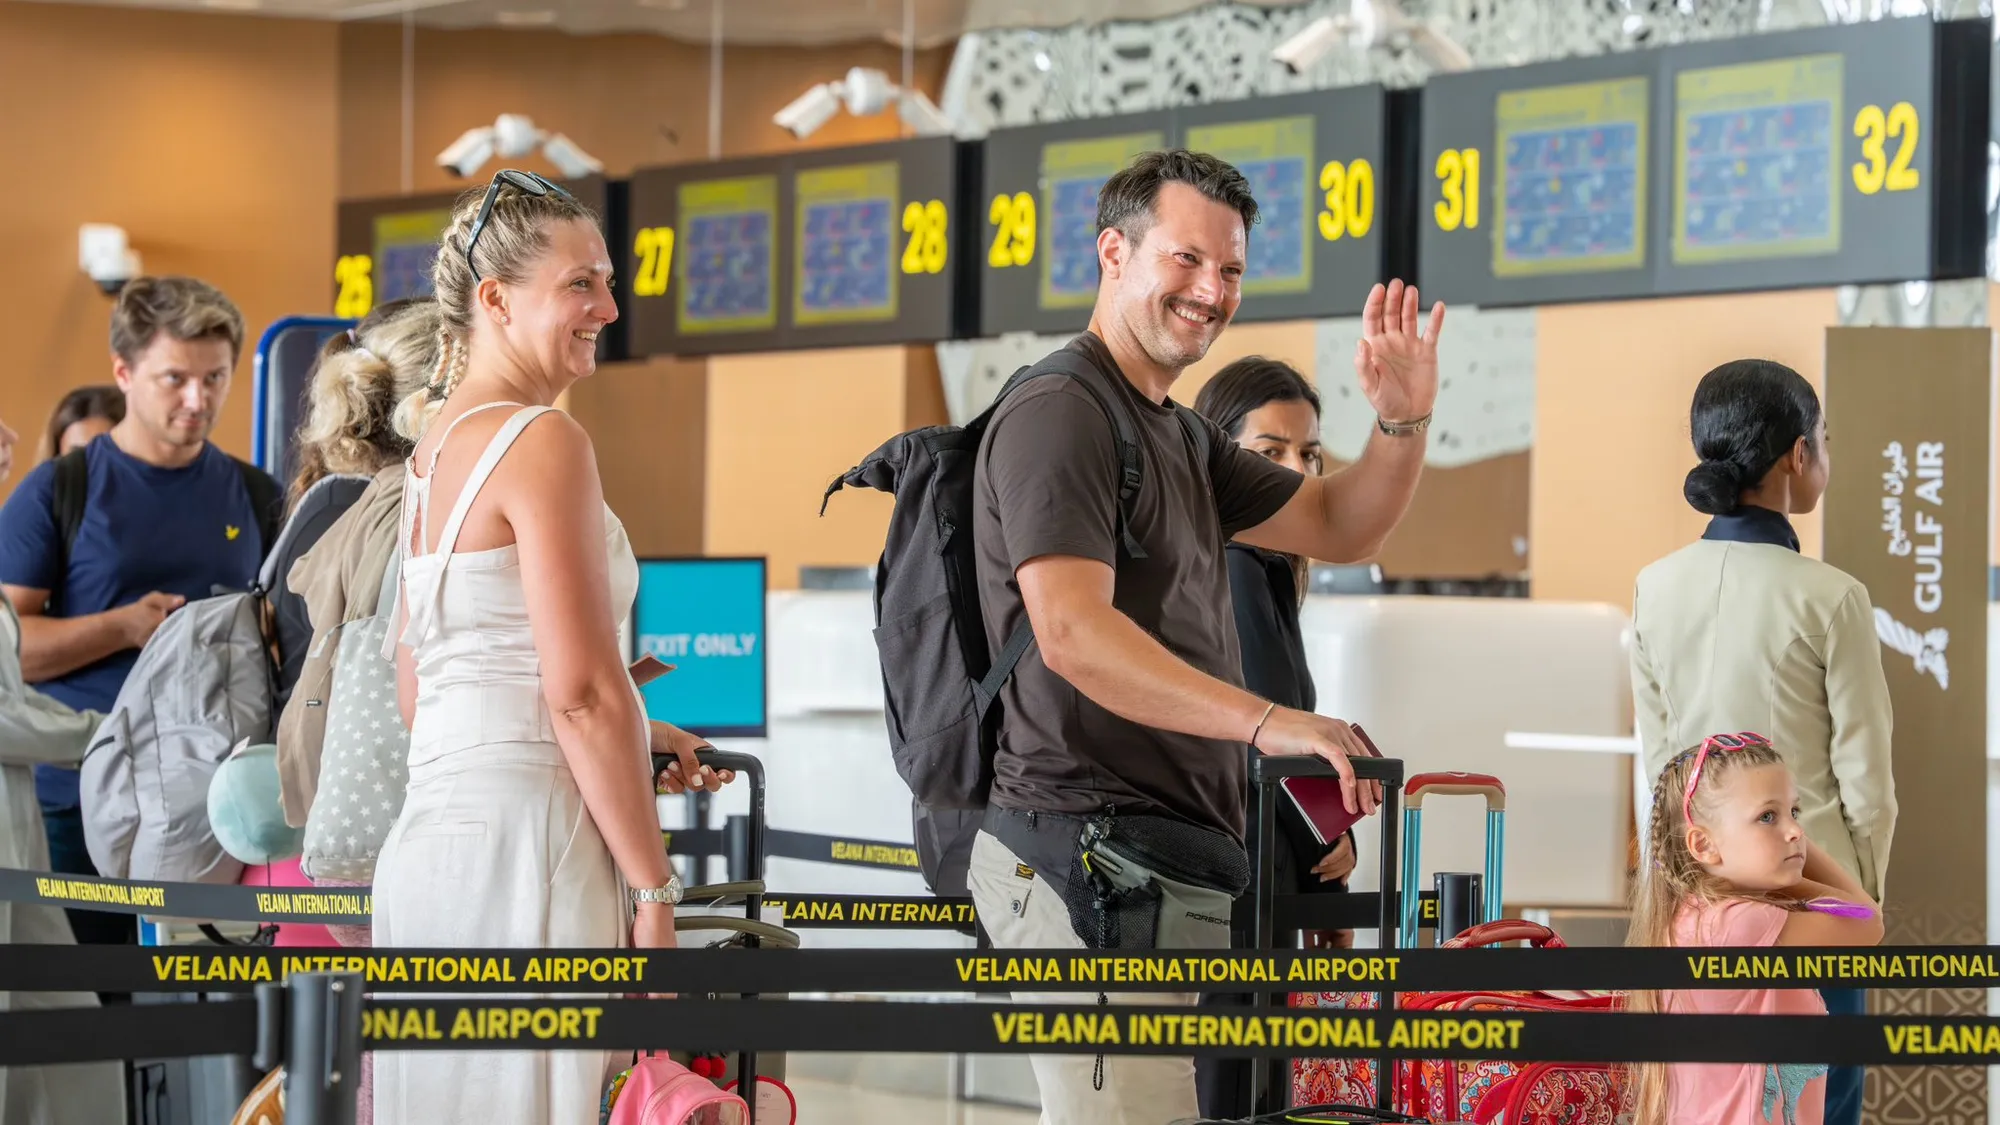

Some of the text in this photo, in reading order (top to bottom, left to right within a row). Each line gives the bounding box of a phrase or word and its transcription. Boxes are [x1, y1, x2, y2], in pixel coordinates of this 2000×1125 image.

[1852, 101, 1920, 195] 32
[1318, 158, 1375, 241] 30
[1434, 147, 1480, 232] 31
[901, 199, 949, 275] 28
[988, 191, 1037, 268] 29
[633, 226, 676, 297] 27
[1914, 441, 1944, 613] GULF AIR
[693, 632, 757, 657] ONLY
[36, 878, 165, 907] VELANA INTERNATIONAL AIRPORT
[257, 893, 291, 913] VELANA
[292, 894, 362, 915] INTERNATIONAL
[152, 956, 649, 983] VELANA INTERNATIONAL AIRPORT
[956, 957, 1400, 983] VELANA INTERNATIONAL AIRPORT
[1688, 955, 2000, 979] VELANA INTERNATIONAL
[450, 1007, 604, 1040] AIRPORT
[993, 1011, 1525, 1050] VELANA INTERNATIONAL AIRPORT
[1883, 1024, 2000, 1055] VELANA
